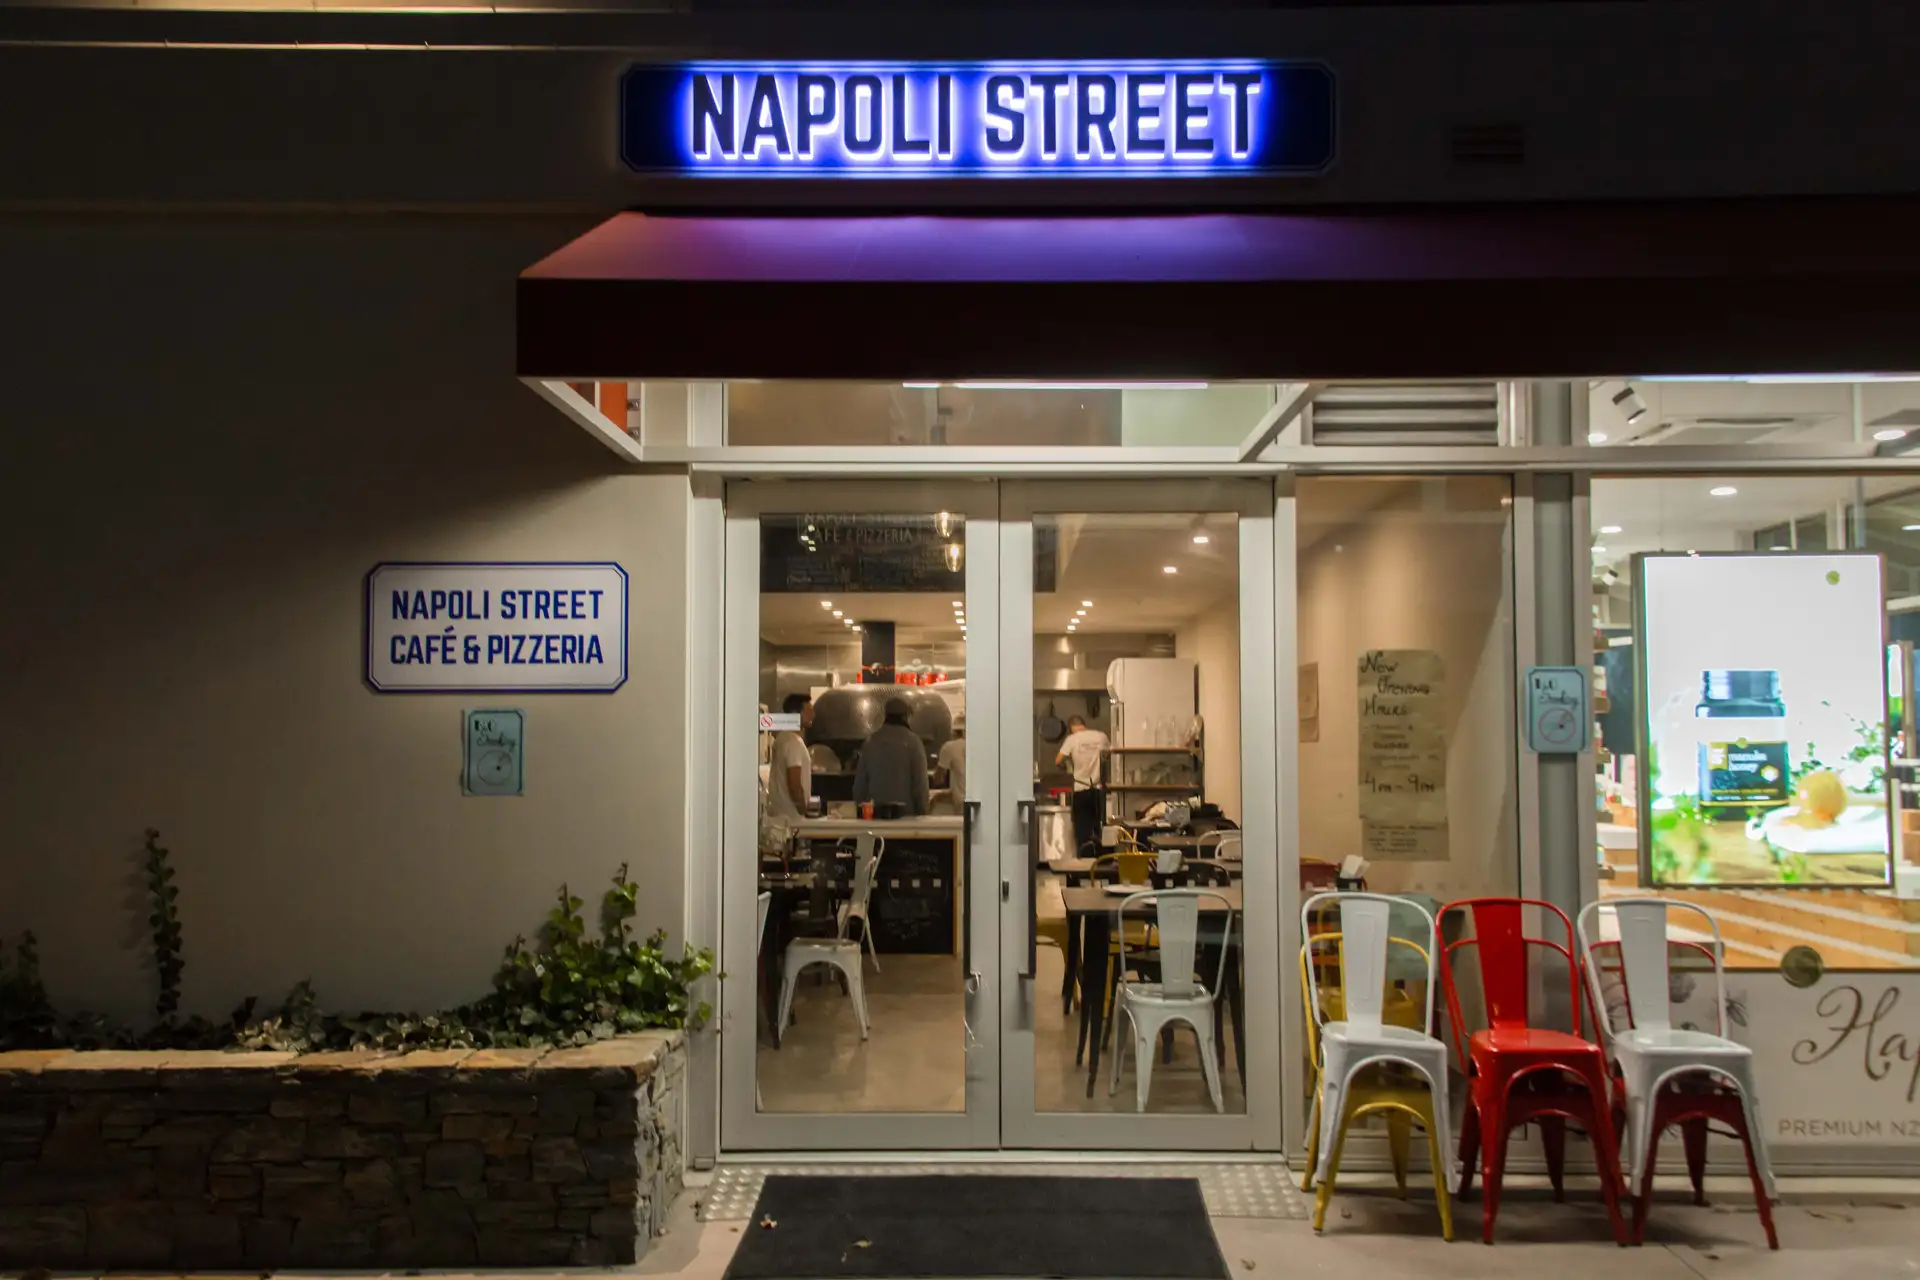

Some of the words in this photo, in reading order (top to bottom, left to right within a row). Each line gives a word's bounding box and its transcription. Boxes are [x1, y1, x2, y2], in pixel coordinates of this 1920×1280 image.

[693, 73, 952, 159] NAPOLI
[984, 73, 1262, 159] STREET
[857, 527, 916, 544] PIZZERIA
[392, 590, 489, 620] NAPOLI
[500, 590, 603, 620] STREET
[390, 625, 457, 664] CAFÉ
[463, 635, 480, 664] &
[487, 635, 604, 664] PIZZERIA
[1779, 1119, 1882, 1137] PREMIUM
